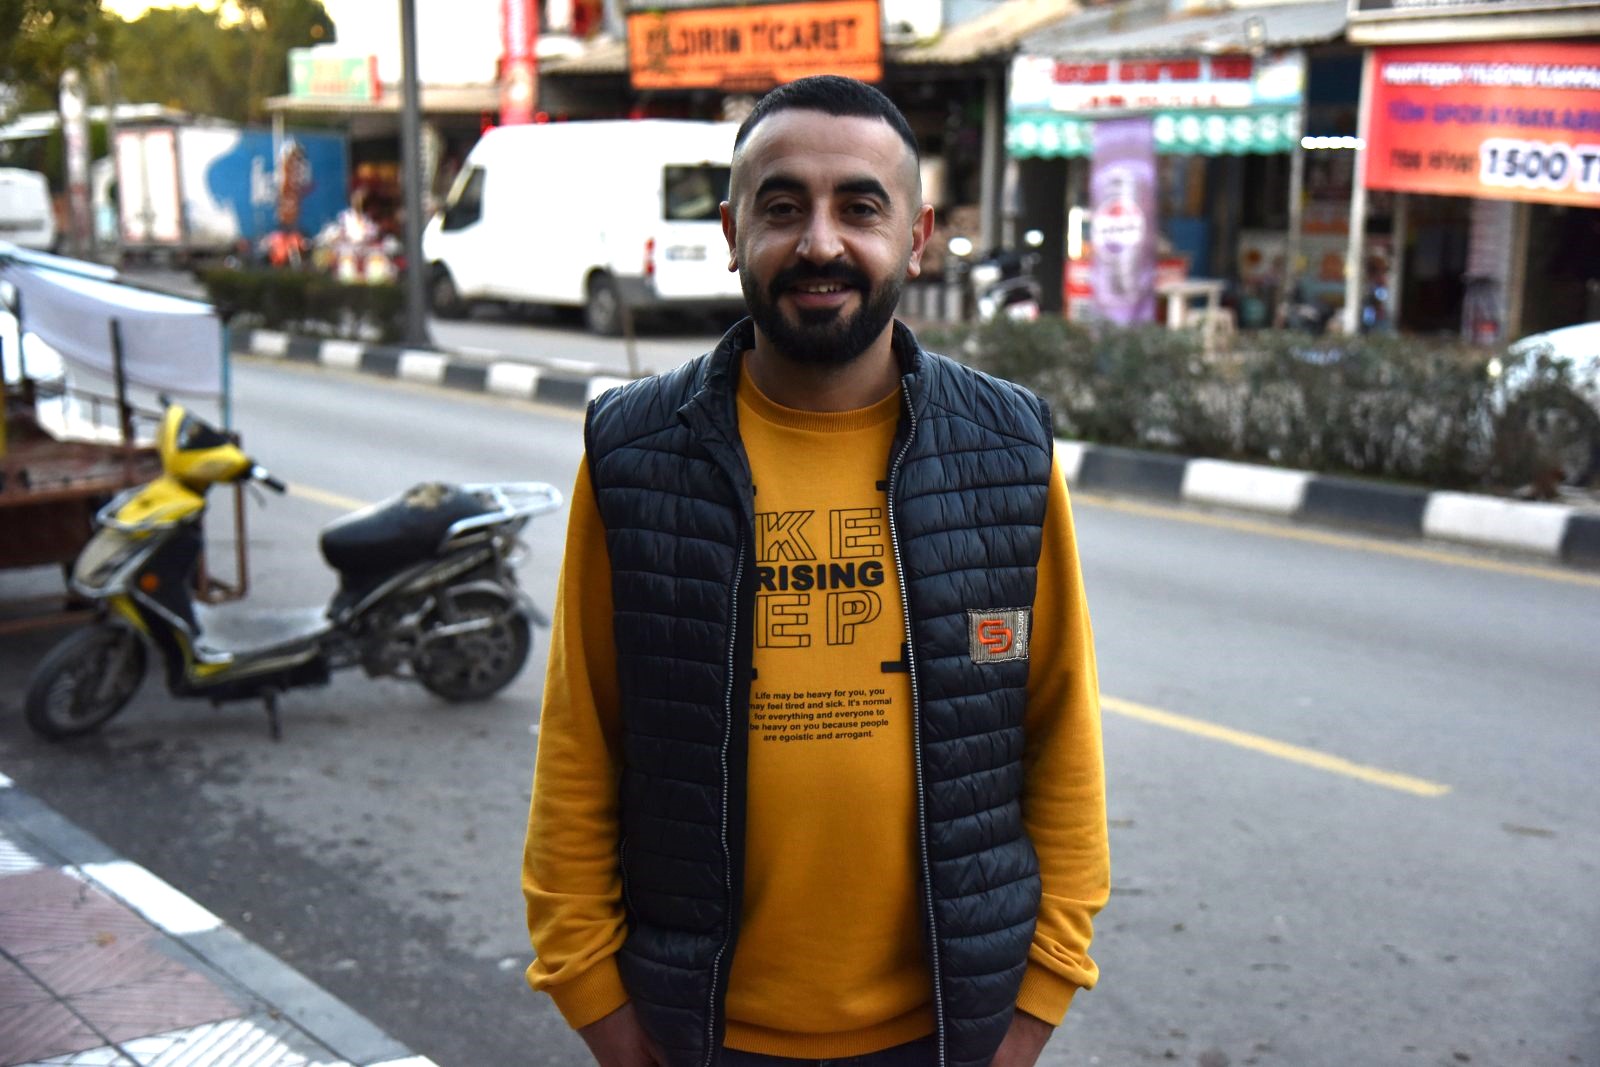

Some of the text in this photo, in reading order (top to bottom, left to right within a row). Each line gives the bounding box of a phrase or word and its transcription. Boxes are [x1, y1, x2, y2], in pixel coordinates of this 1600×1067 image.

[1488, 148, 1568, 181] 1500
[754, 561, 884, 591] RISING
[755, 692, 771, 700] Life
[806, 691, 832, 699] heavy
[848, 689, 867, 698] you,
[869, 688, 885, 697] you
[767, 702, 783, 710] feel
[807, 701, 823, 709] and
[826, 700, 845, 708] sick.
[848, 698, 860, 706] It's
[863, 698, 892, 706] normal
[768, 712, 814, 721] everything
[816, 711, 832, 719] and
[835, 710, 874, 719] everyone
[876, 708, 885, 716] to
[762, 723, 787, 732] heavy
[804, 722, 820, 731] you
[822, 721, 858, 729] because
[860, 719, 889, 729] people
[780, 732, 814, 742] egoistic
[816, 732, 833, 740] and
[835, 731, 874, 740] arrogant.
